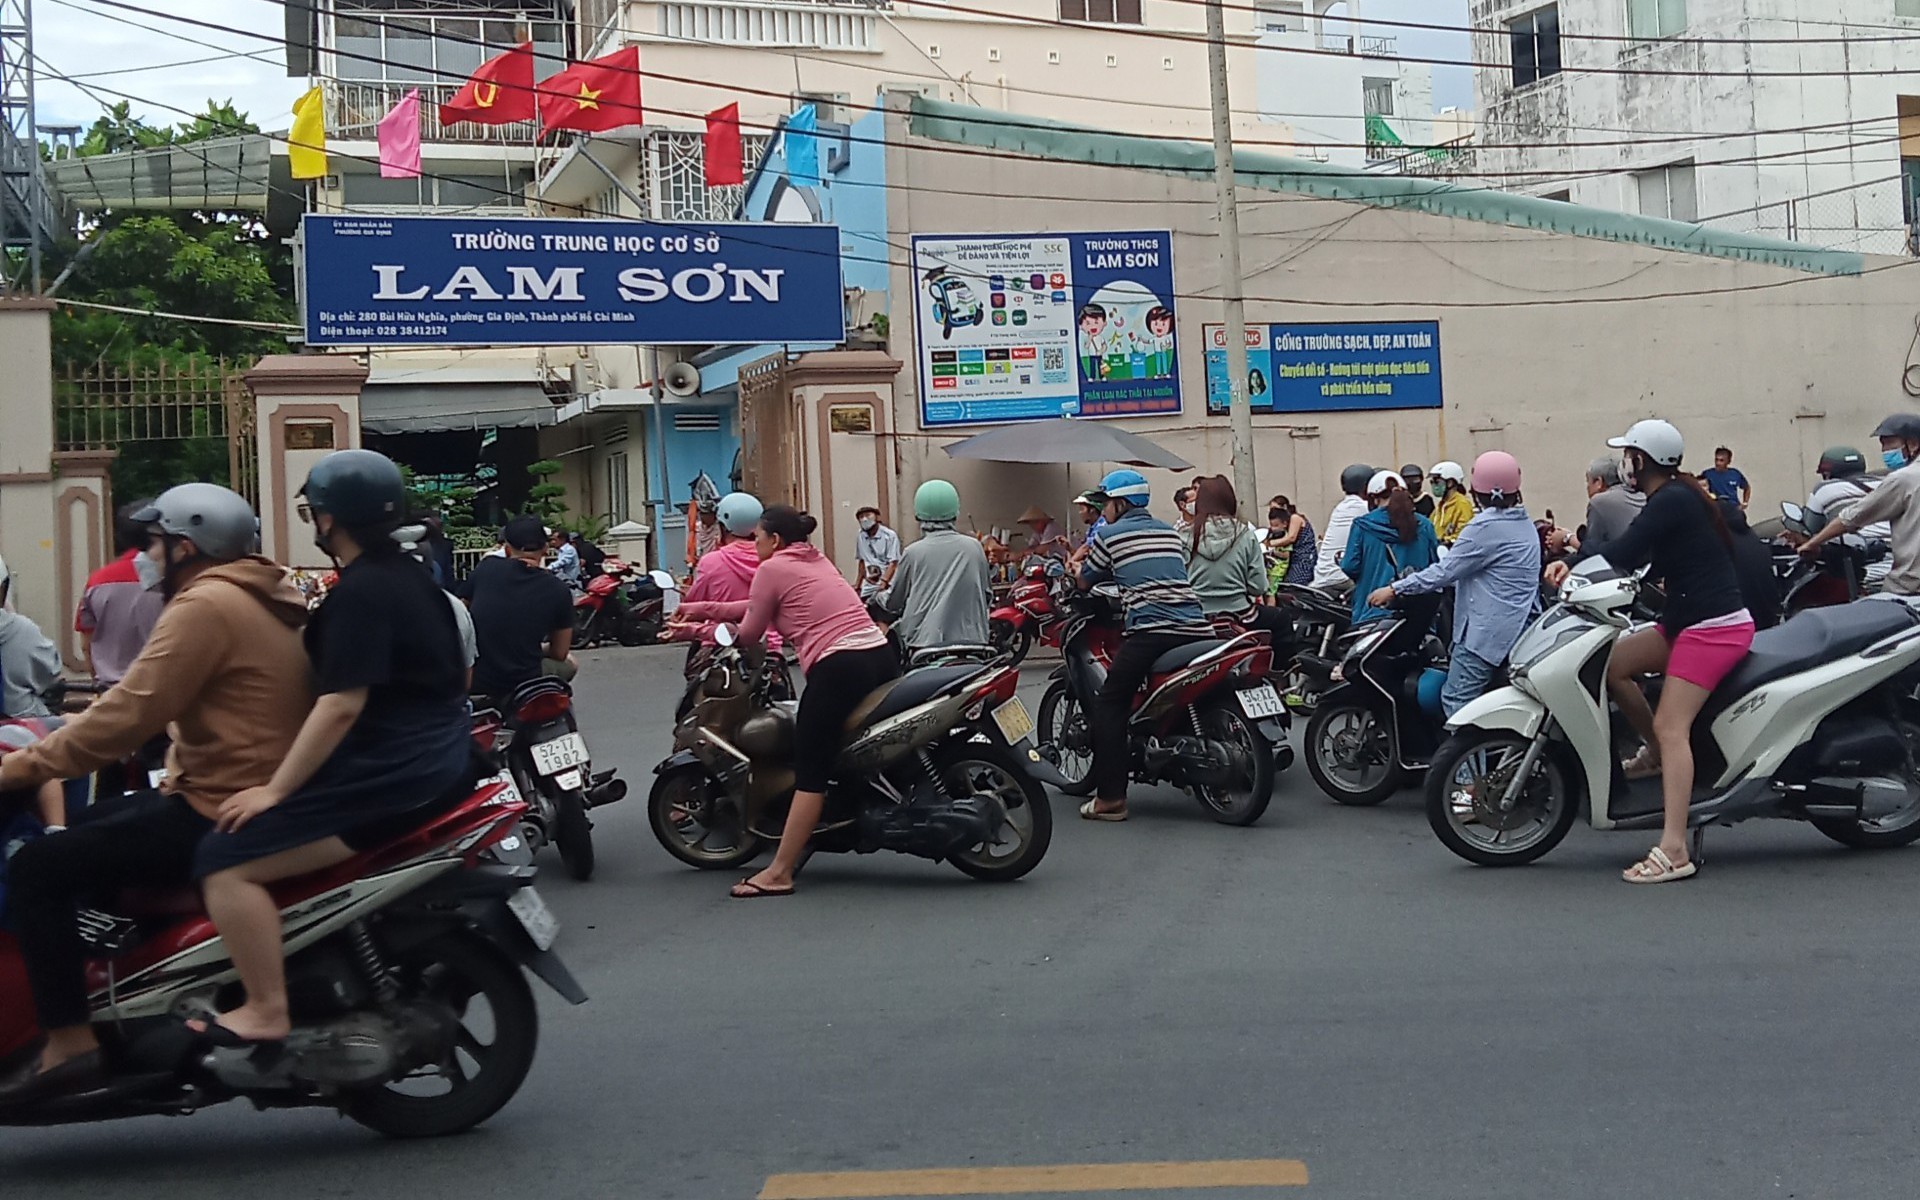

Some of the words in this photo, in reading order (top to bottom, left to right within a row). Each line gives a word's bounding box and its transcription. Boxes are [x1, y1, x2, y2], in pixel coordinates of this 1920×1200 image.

[452, 228, 536, 250] TRƯỜNG
[541, 235, 608, 251] TRUNG
[614, 236, 655, 256] HỌC
[661, 234, 689, 252] CƠ
[694, 230, 721, 253] SỞ
[956, 244, 982, 252] THANH
[1084, 238, 1130, 251] TRƯỜNG
[1130, 239, 1159, 250] THCS
[1086, 253, 1122, 269] LAM
[1124, 252, 1159, 268] SƠN
[371, 264, 586, 300] LAM
[617, 262, 785, 302] SƠN
[320, 312, 336, 323] Địa
[338, 310, 356, 321] chỉ:
[358, 312, 378, 321] 280
[380, 310, 395, 321] Bùi
[397, 311, 416, 321] Hữu
[418, 312, 448, 323] Nghĩa,
[450, 310, 484, 323] phường
[486, 312, 502, 322] Gia
[504, 312, 529, 323] Định,
[530, 312, 558, 322] Thành
[560, 311, 578, 322] phố
[579, 310, 592, 322] Hồ
[594, 312, 610, 322] Chí
[612, 312, 635, 322] Minh
[320, 326, 343, 338] Điện
[346, 326, 374, 338] thoại:
[376, 326, 398, 336] 028
[400, 326, 448, 336] 38412174
[1274, 332, 1302, 351] CỔNG
[1303, 332, 1342, 350] TRƯỜNG
[1344, 334, 1372, 353] SẠCH,
[1392, 334, 1406, 349] AN
[1406, 331, 1432, 348] TOÀN
[1249, 700, 1281, 718] 7142
[544, 750, 582, 771] 1982
